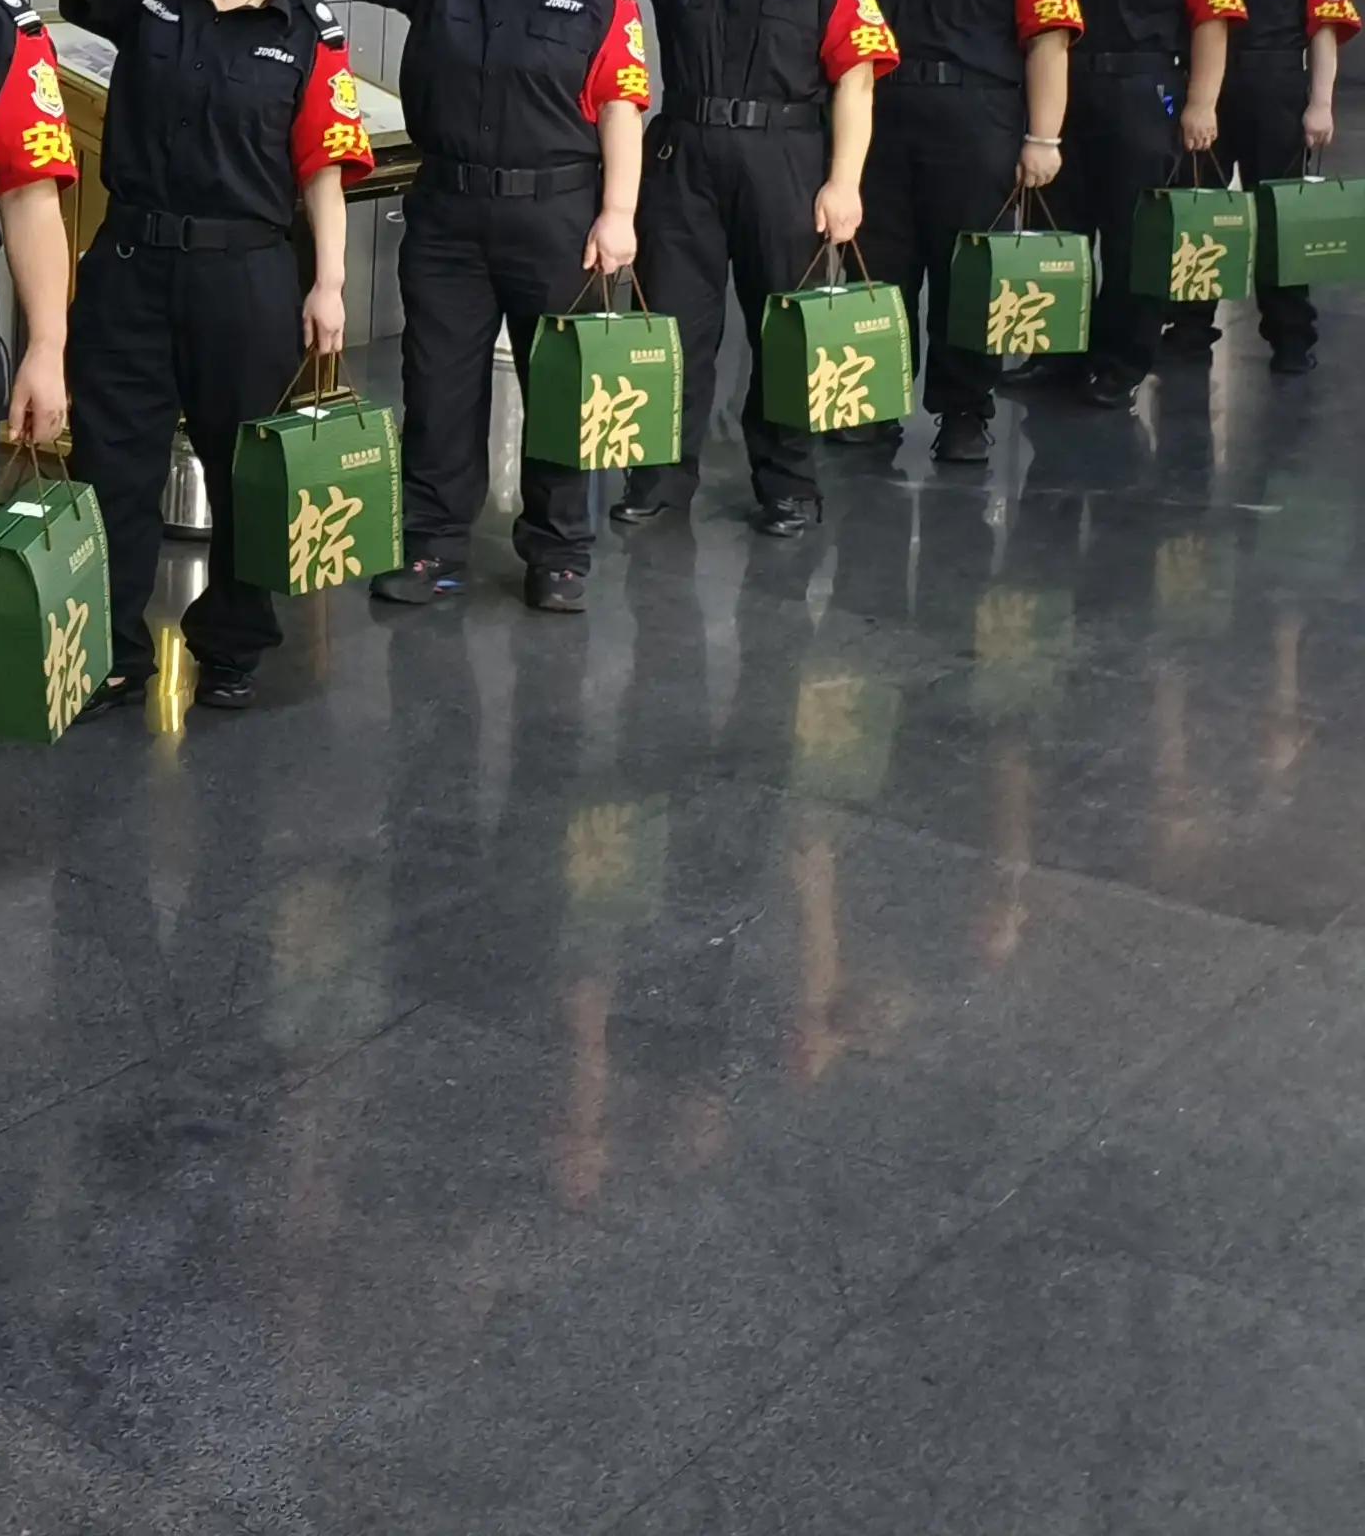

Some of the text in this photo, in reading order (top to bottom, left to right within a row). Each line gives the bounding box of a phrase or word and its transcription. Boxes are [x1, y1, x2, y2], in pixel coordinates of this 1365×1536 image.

[986, 279, 1056, 355] 粽
[580, 373, 649, 471] 粽
[808, 345, 876, 432] 粽
[288, 485, 364, 594] 粽
